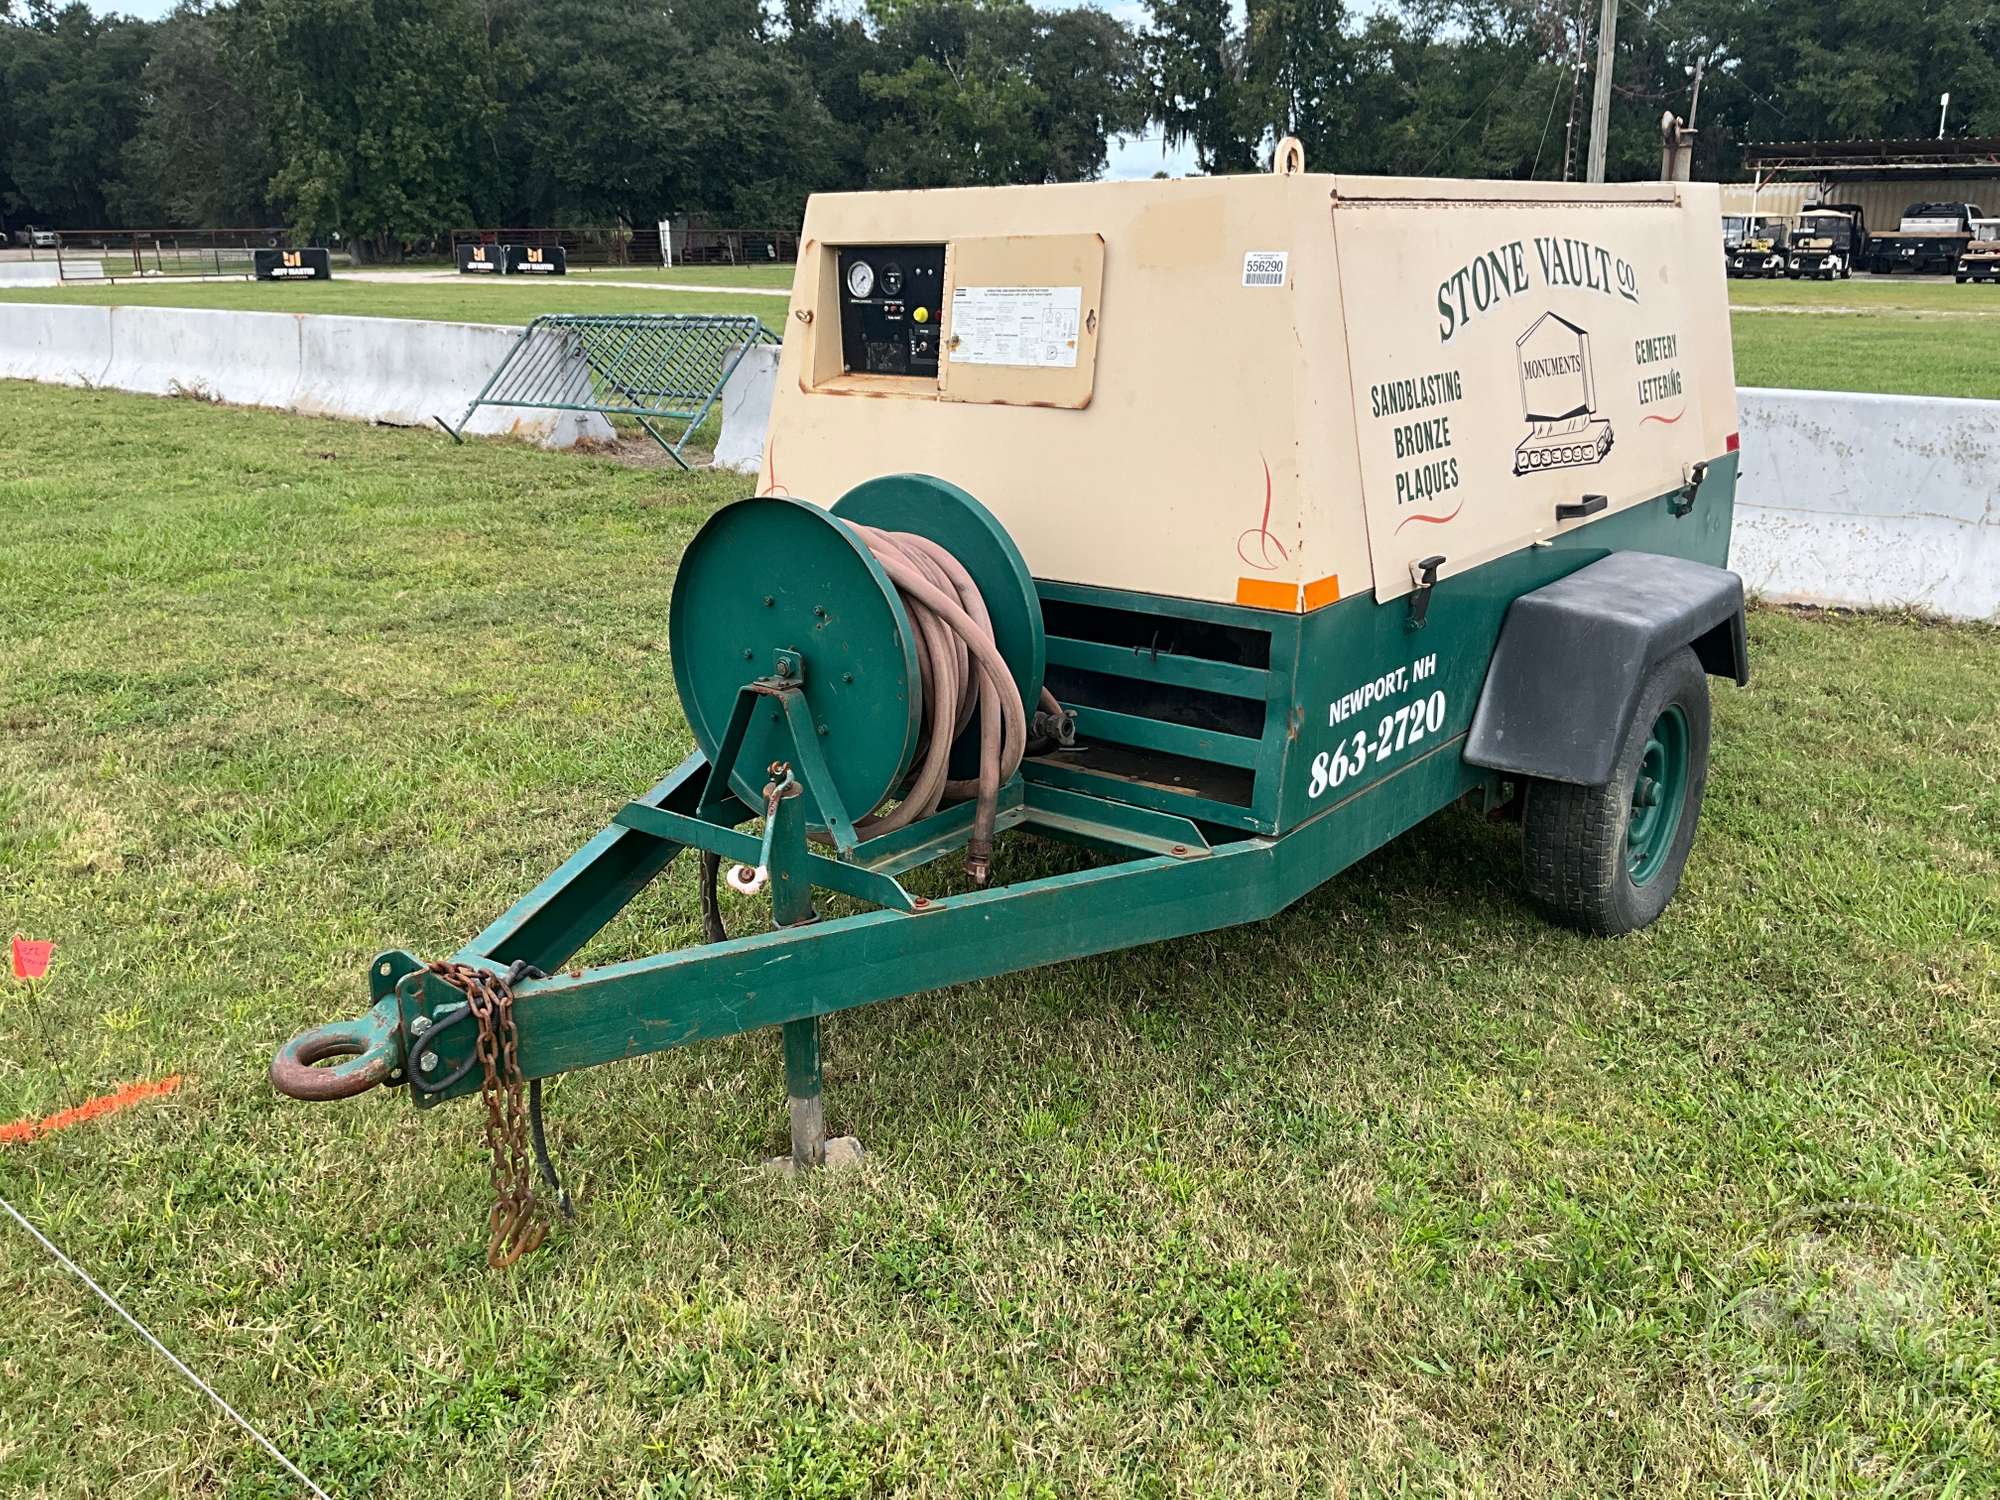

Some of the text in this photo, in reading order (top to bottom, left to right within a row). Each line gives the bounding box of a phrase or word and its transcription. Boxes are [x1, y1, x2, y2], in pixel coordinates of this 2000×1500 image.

[1246, 260, 1283, 272] 556290
[1437, 241, 1529, 344] STONE
[1533, 236, 1613, 295] VAULT
[1523, 354, 1582, 380] MONUMENTS
[1635, 333, 1677, 366] CEMETERY
[1371, 369, 1463, 419] SANDBLASTING
[1637, 368, 1682, 406] LETTERING
[1393, 416, 1452, 460] BRONZE
[1396, 457, 1459, 505] PLAQUES
[1328, 652, 1437, 728] NEWPORT, NH
[1307, 690, 1447, 799] 863-2720
